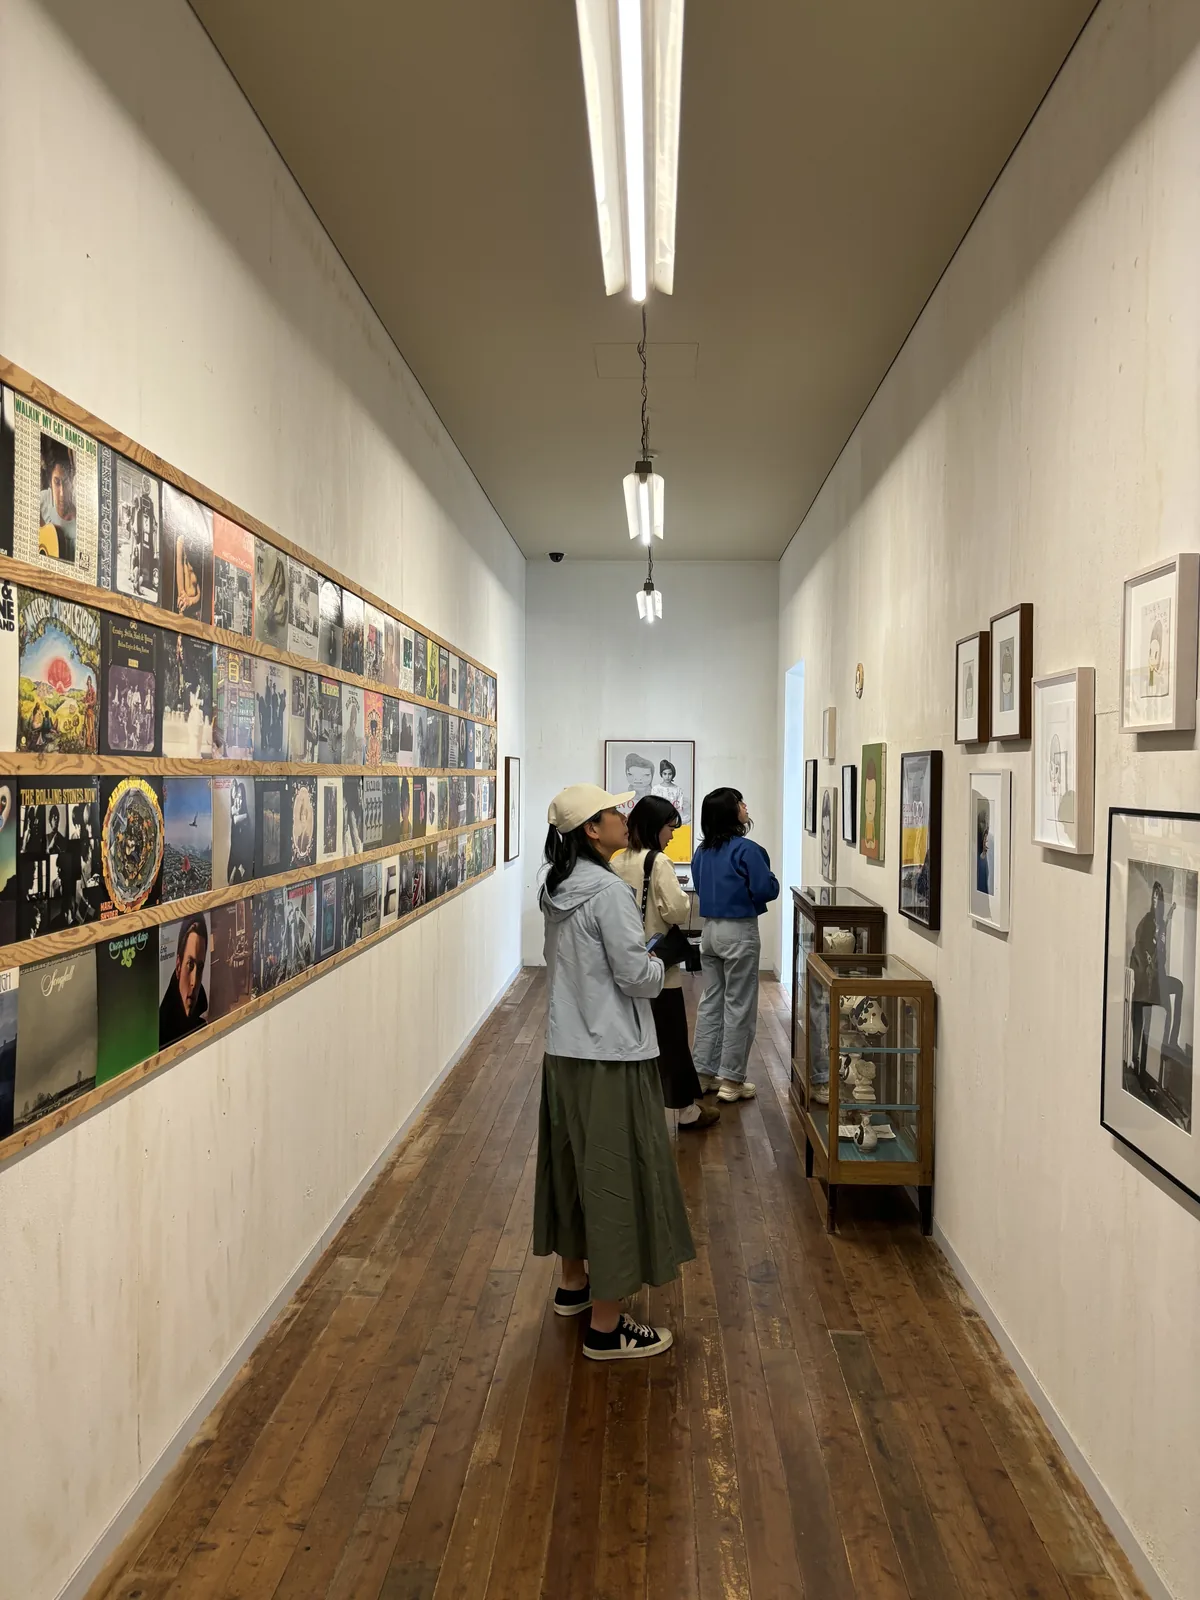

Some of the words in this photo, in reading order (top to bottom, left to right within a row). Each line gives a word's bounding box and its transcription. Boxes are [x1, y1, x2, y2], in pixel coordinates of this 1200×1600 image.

[15, 397, 41, 423] WALKIN'
[42, 413, 52, 431] MY
[53, 420, 64, 438] CAT
[64, 426, 85, 451] NAMED
[85, 439, 97, 457] DOG
[1, 580, 13, 601] &
[20, 788, 34, 805] THE
[35, 788, 62, 805] ROLLING
